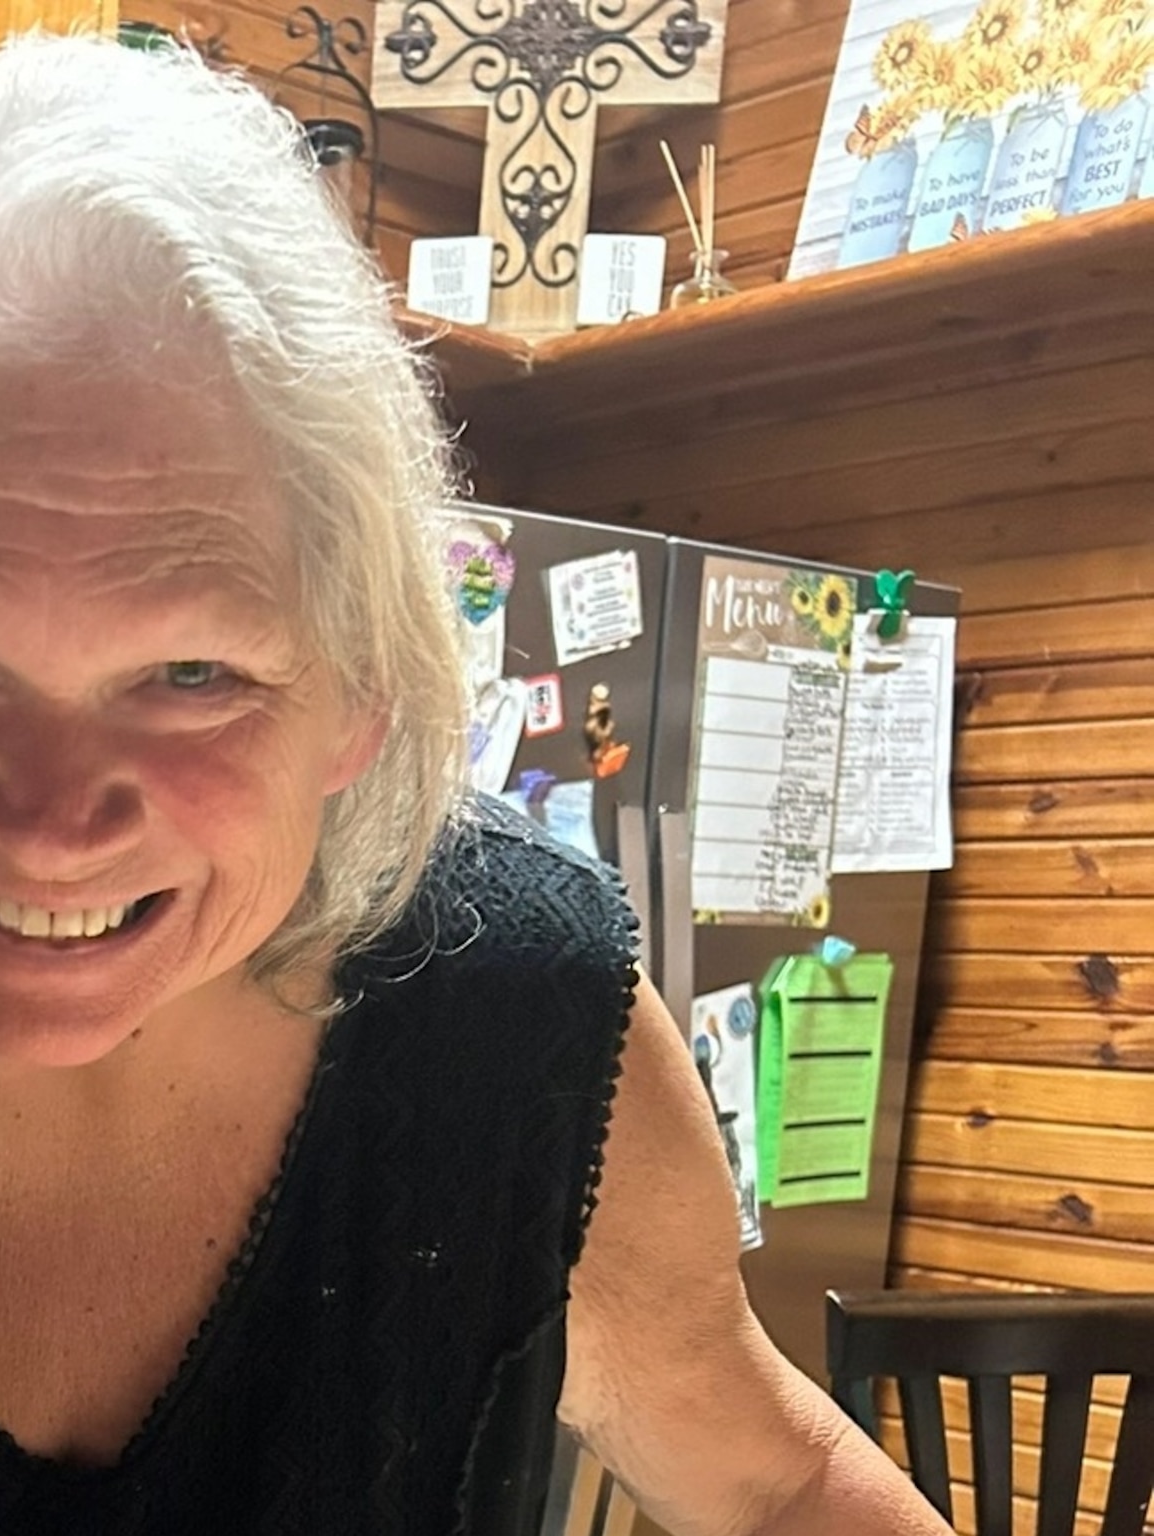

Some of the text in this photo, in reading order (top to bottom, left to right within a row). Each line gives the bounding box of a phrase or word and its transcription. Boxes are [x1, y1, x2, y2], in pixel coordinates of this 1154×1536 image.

[1113, 118, 1134, 135] do
[1010, 147, 1050, 167] To be
[1084, 159, 1122, 183] BEST
[929, 177, 943, 192] To
[1097, 182, 1125, 201] you
[919, 197, 945, 217] BAD
[989, 189, 1047, 217] PERFECT
[612, 241, 636, 266] YES
[609, 267, 635, 293] YOU
[705, 574, 784, 634] Menu
